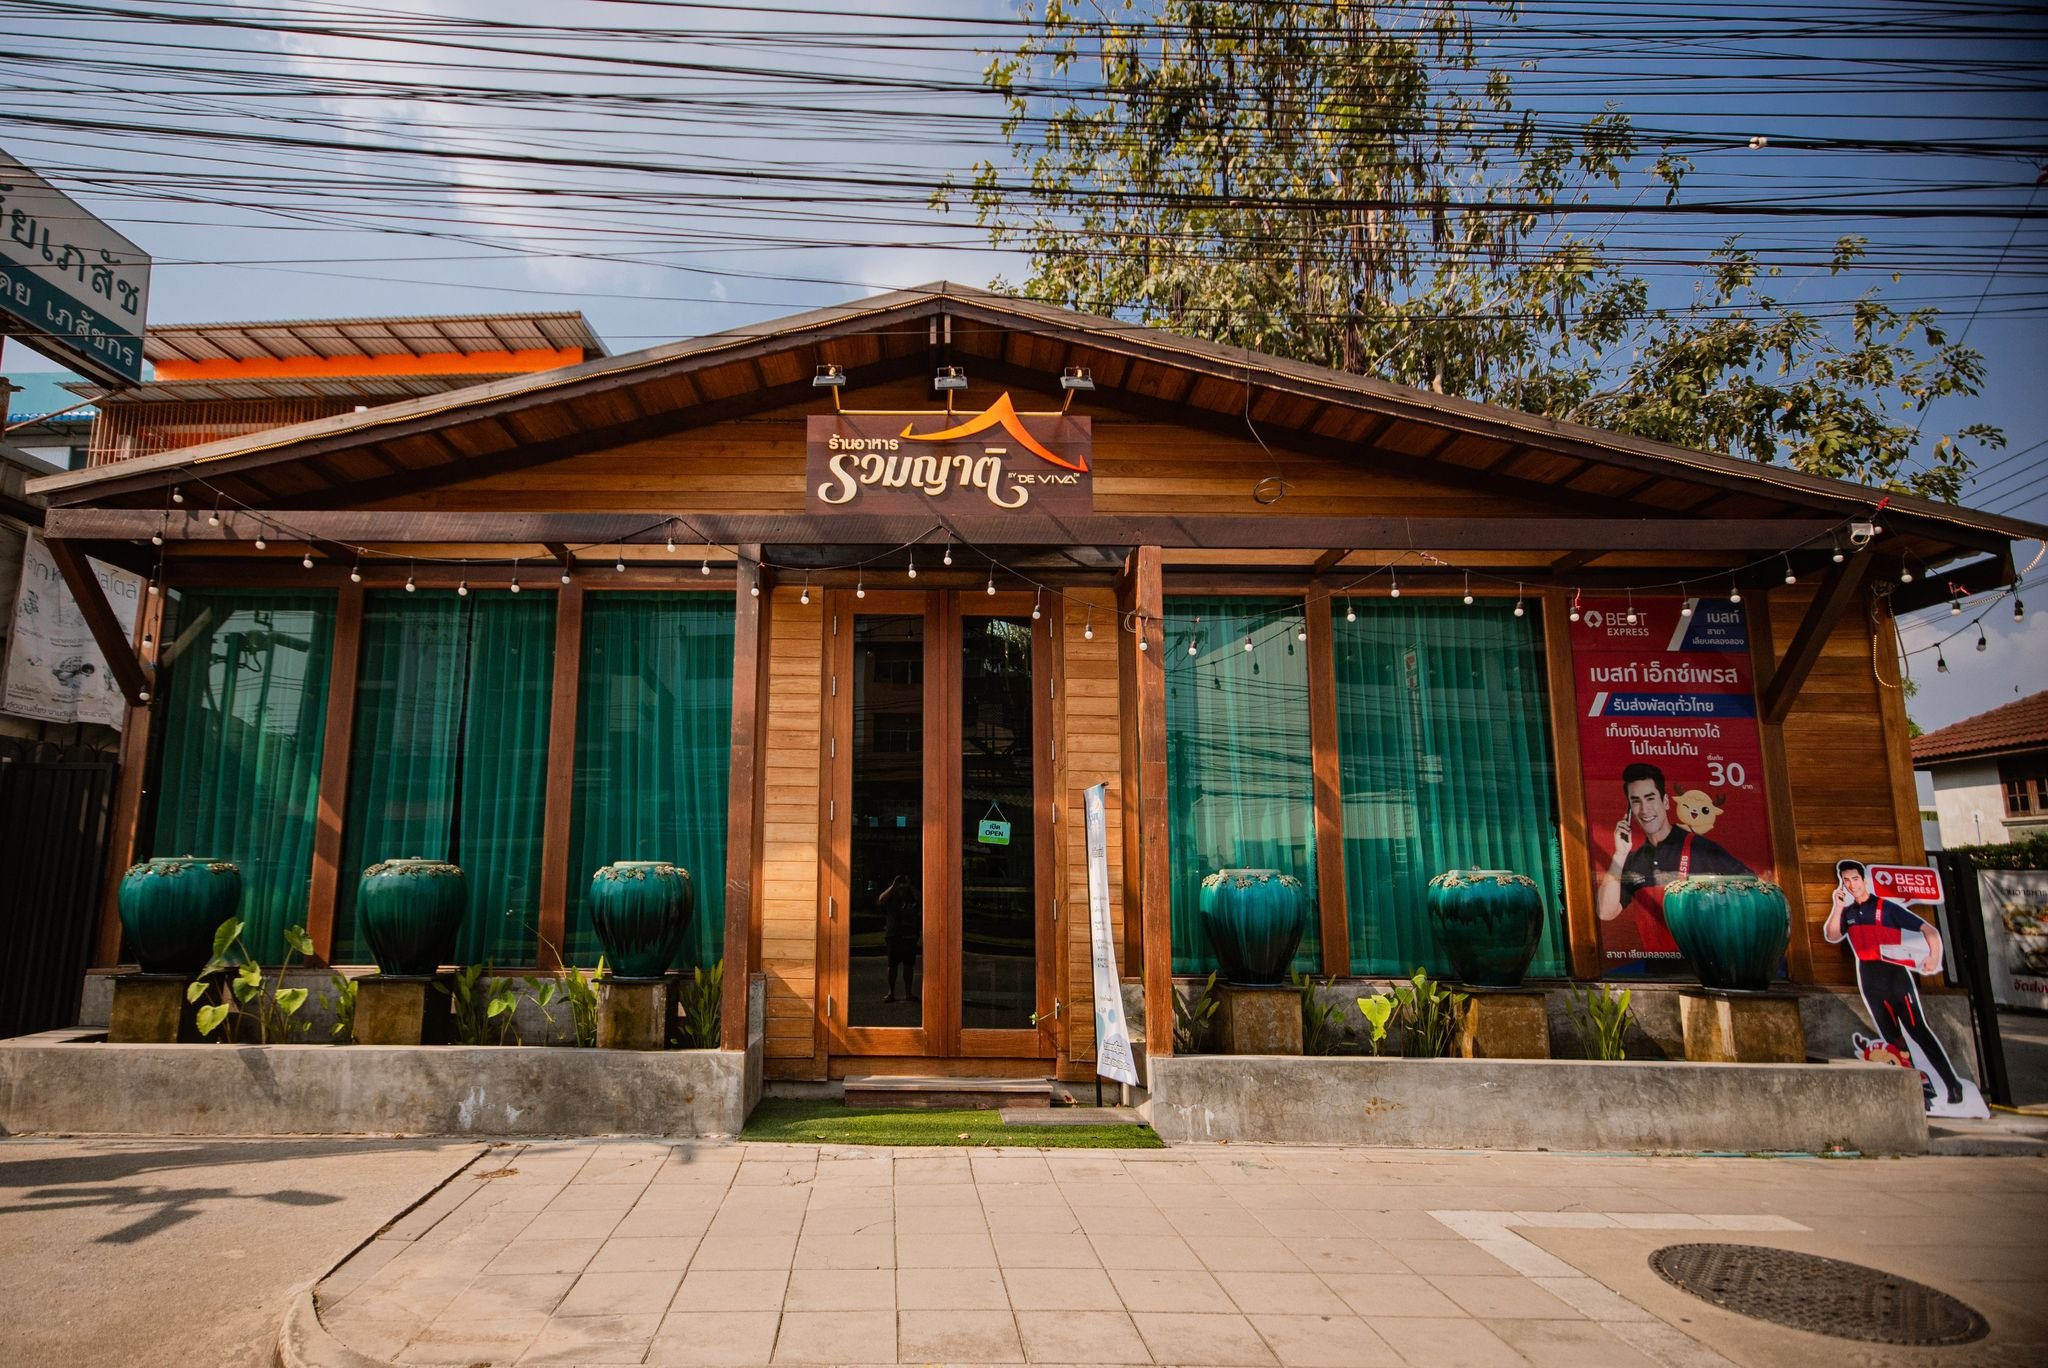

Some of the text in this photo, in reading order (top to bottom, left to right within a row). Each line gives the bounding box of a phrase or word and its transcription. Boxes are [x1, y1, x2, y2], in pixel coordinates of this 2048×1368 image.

[47, 301, 134, 366] เภสัชกร
[828, 434, 899, 450] ร้านอาหาร
[817, 448, 1029, 508] รวมญาติ
[1017, 474, 1036, 484] DE
[1706, 610, 1740, 624] เบสท์
[1607, 627, 1650, 637] EXPRESS
[1590, 661, 1738, 684] เบสท์ เอ็กซ์เพรส
[1613, 695, 1714, 716] รับส่งพัสดุทั่วไทย
[1605, 722, 1721, 739] เก็บเงินปลายทางได้
[1630, 740, 1699, 756] ไปไหนไปกัน
[1706, 762, 1746, 787] 30
[1894, 873, 1934, 887] BEST
[1897, 885, 1937, 895] EXPRESS
[1606, 948, 1685, 960] สาขา เลียบคลองสอ
